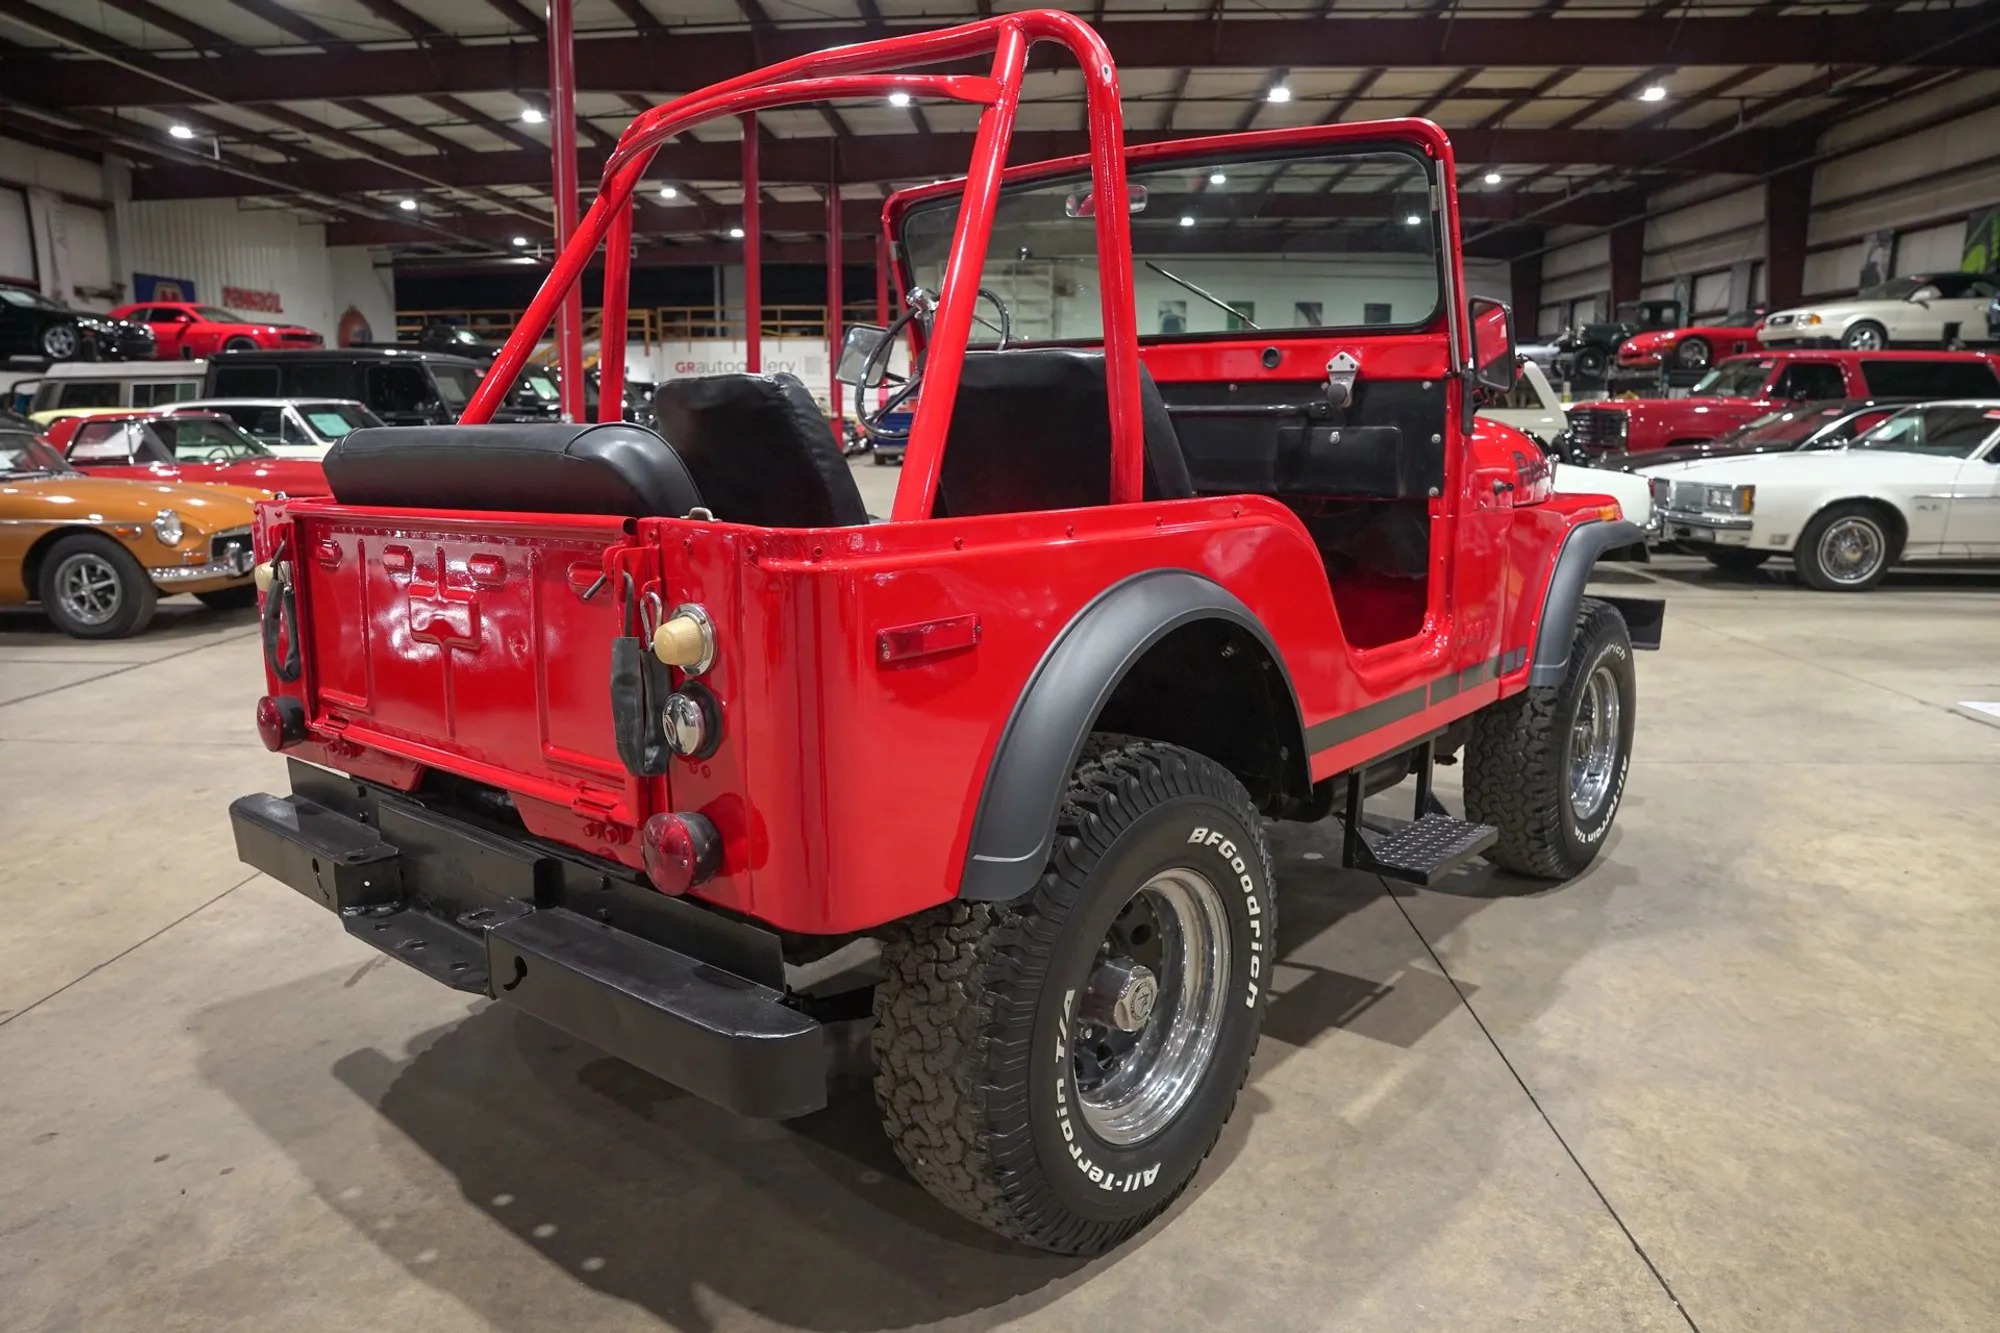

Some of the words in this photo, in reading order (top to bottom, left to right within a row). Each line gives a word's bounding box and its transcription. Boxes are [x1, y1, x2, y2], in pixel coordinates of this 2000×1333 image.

[675, 356, 796, 374] GRautoglery
[1187, 827, 1263, 1009] BFGoodrich
[1055, 989, 1076, 1063] T/A
[1056, 1078, 1161, 1193] All-Terrain
